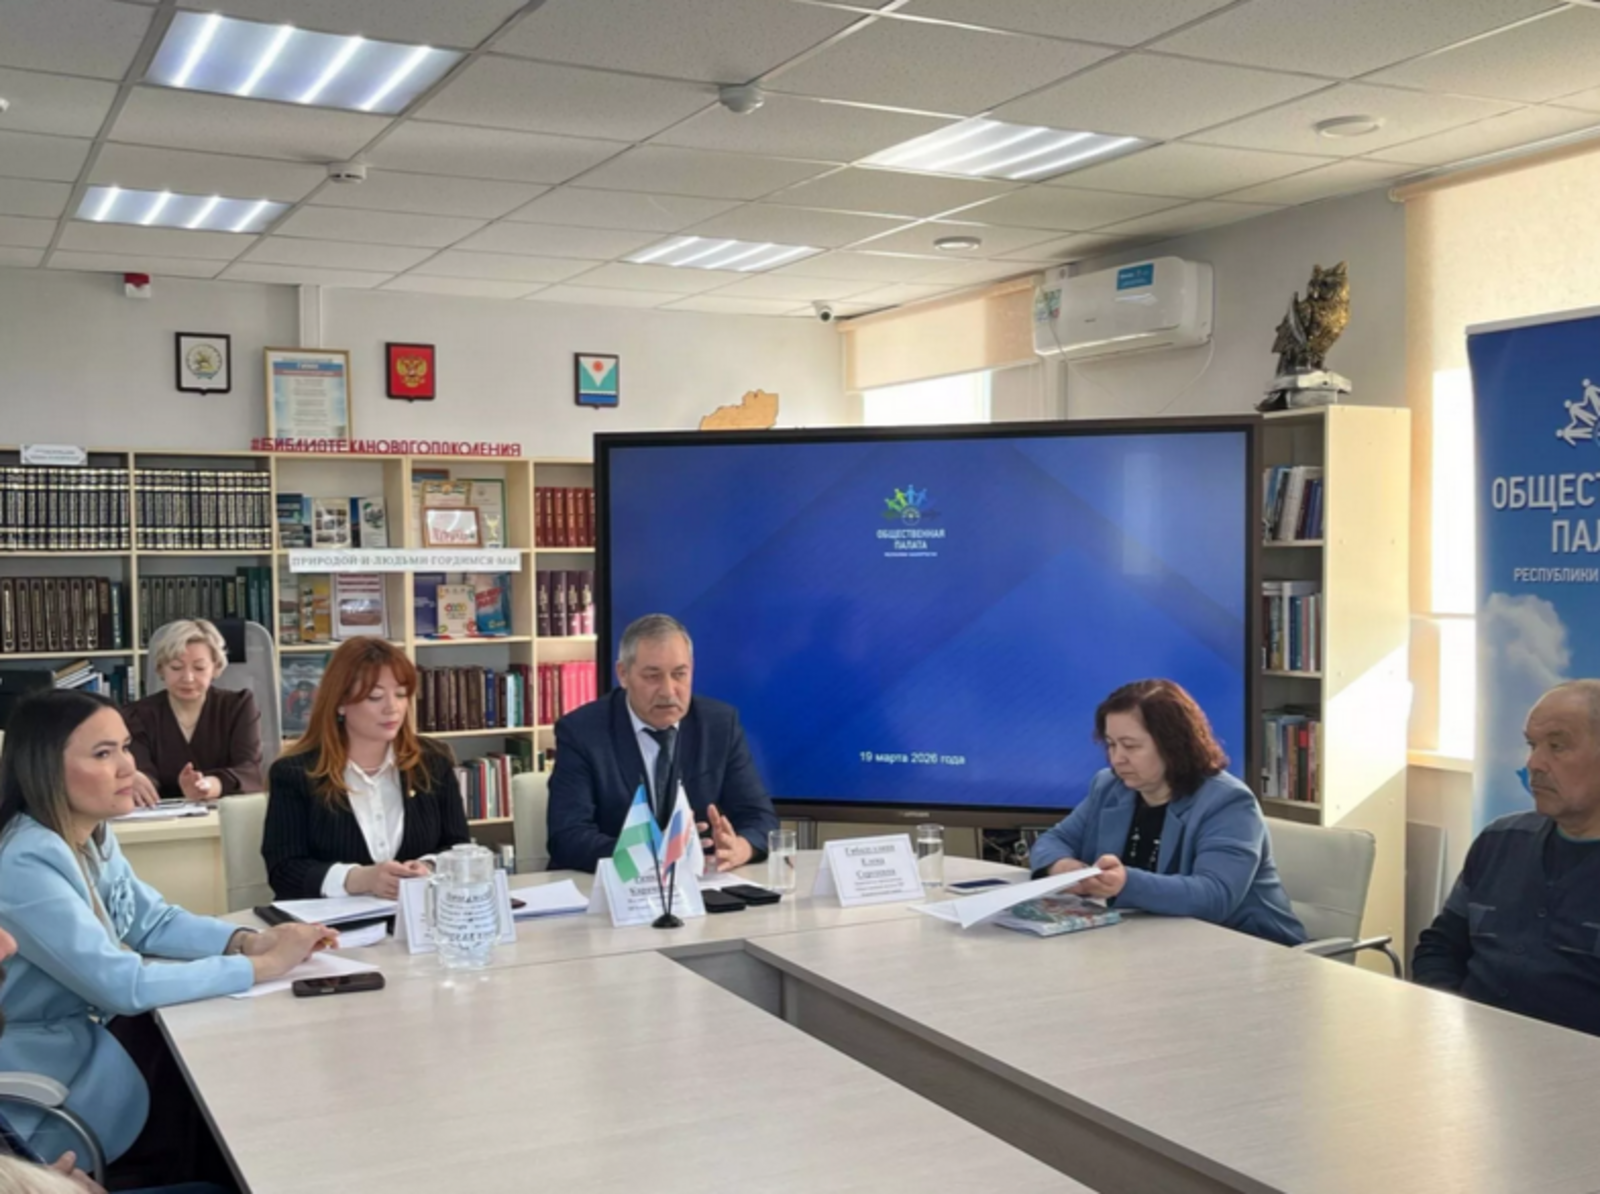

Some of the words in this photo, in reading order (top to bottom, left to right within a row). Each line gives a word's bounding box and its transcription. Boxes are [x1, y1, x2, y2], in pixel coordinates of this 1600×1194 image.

[1492, 472, 1600, 513] ОБЩЕС
[292, 554, 358, 567] ПРИРОДОЙ
[374, 555, 428, 566] ЛЮДЬМИ
[431, 555, 494, 565] ГОРДИМСЯ
[1513, 567, 1599, 582] РЕСПУБЛИКИ
[859, 751, 873, 762] 19
[875, 754, 909, 765] марта
[941, 755, 966, 765] года
